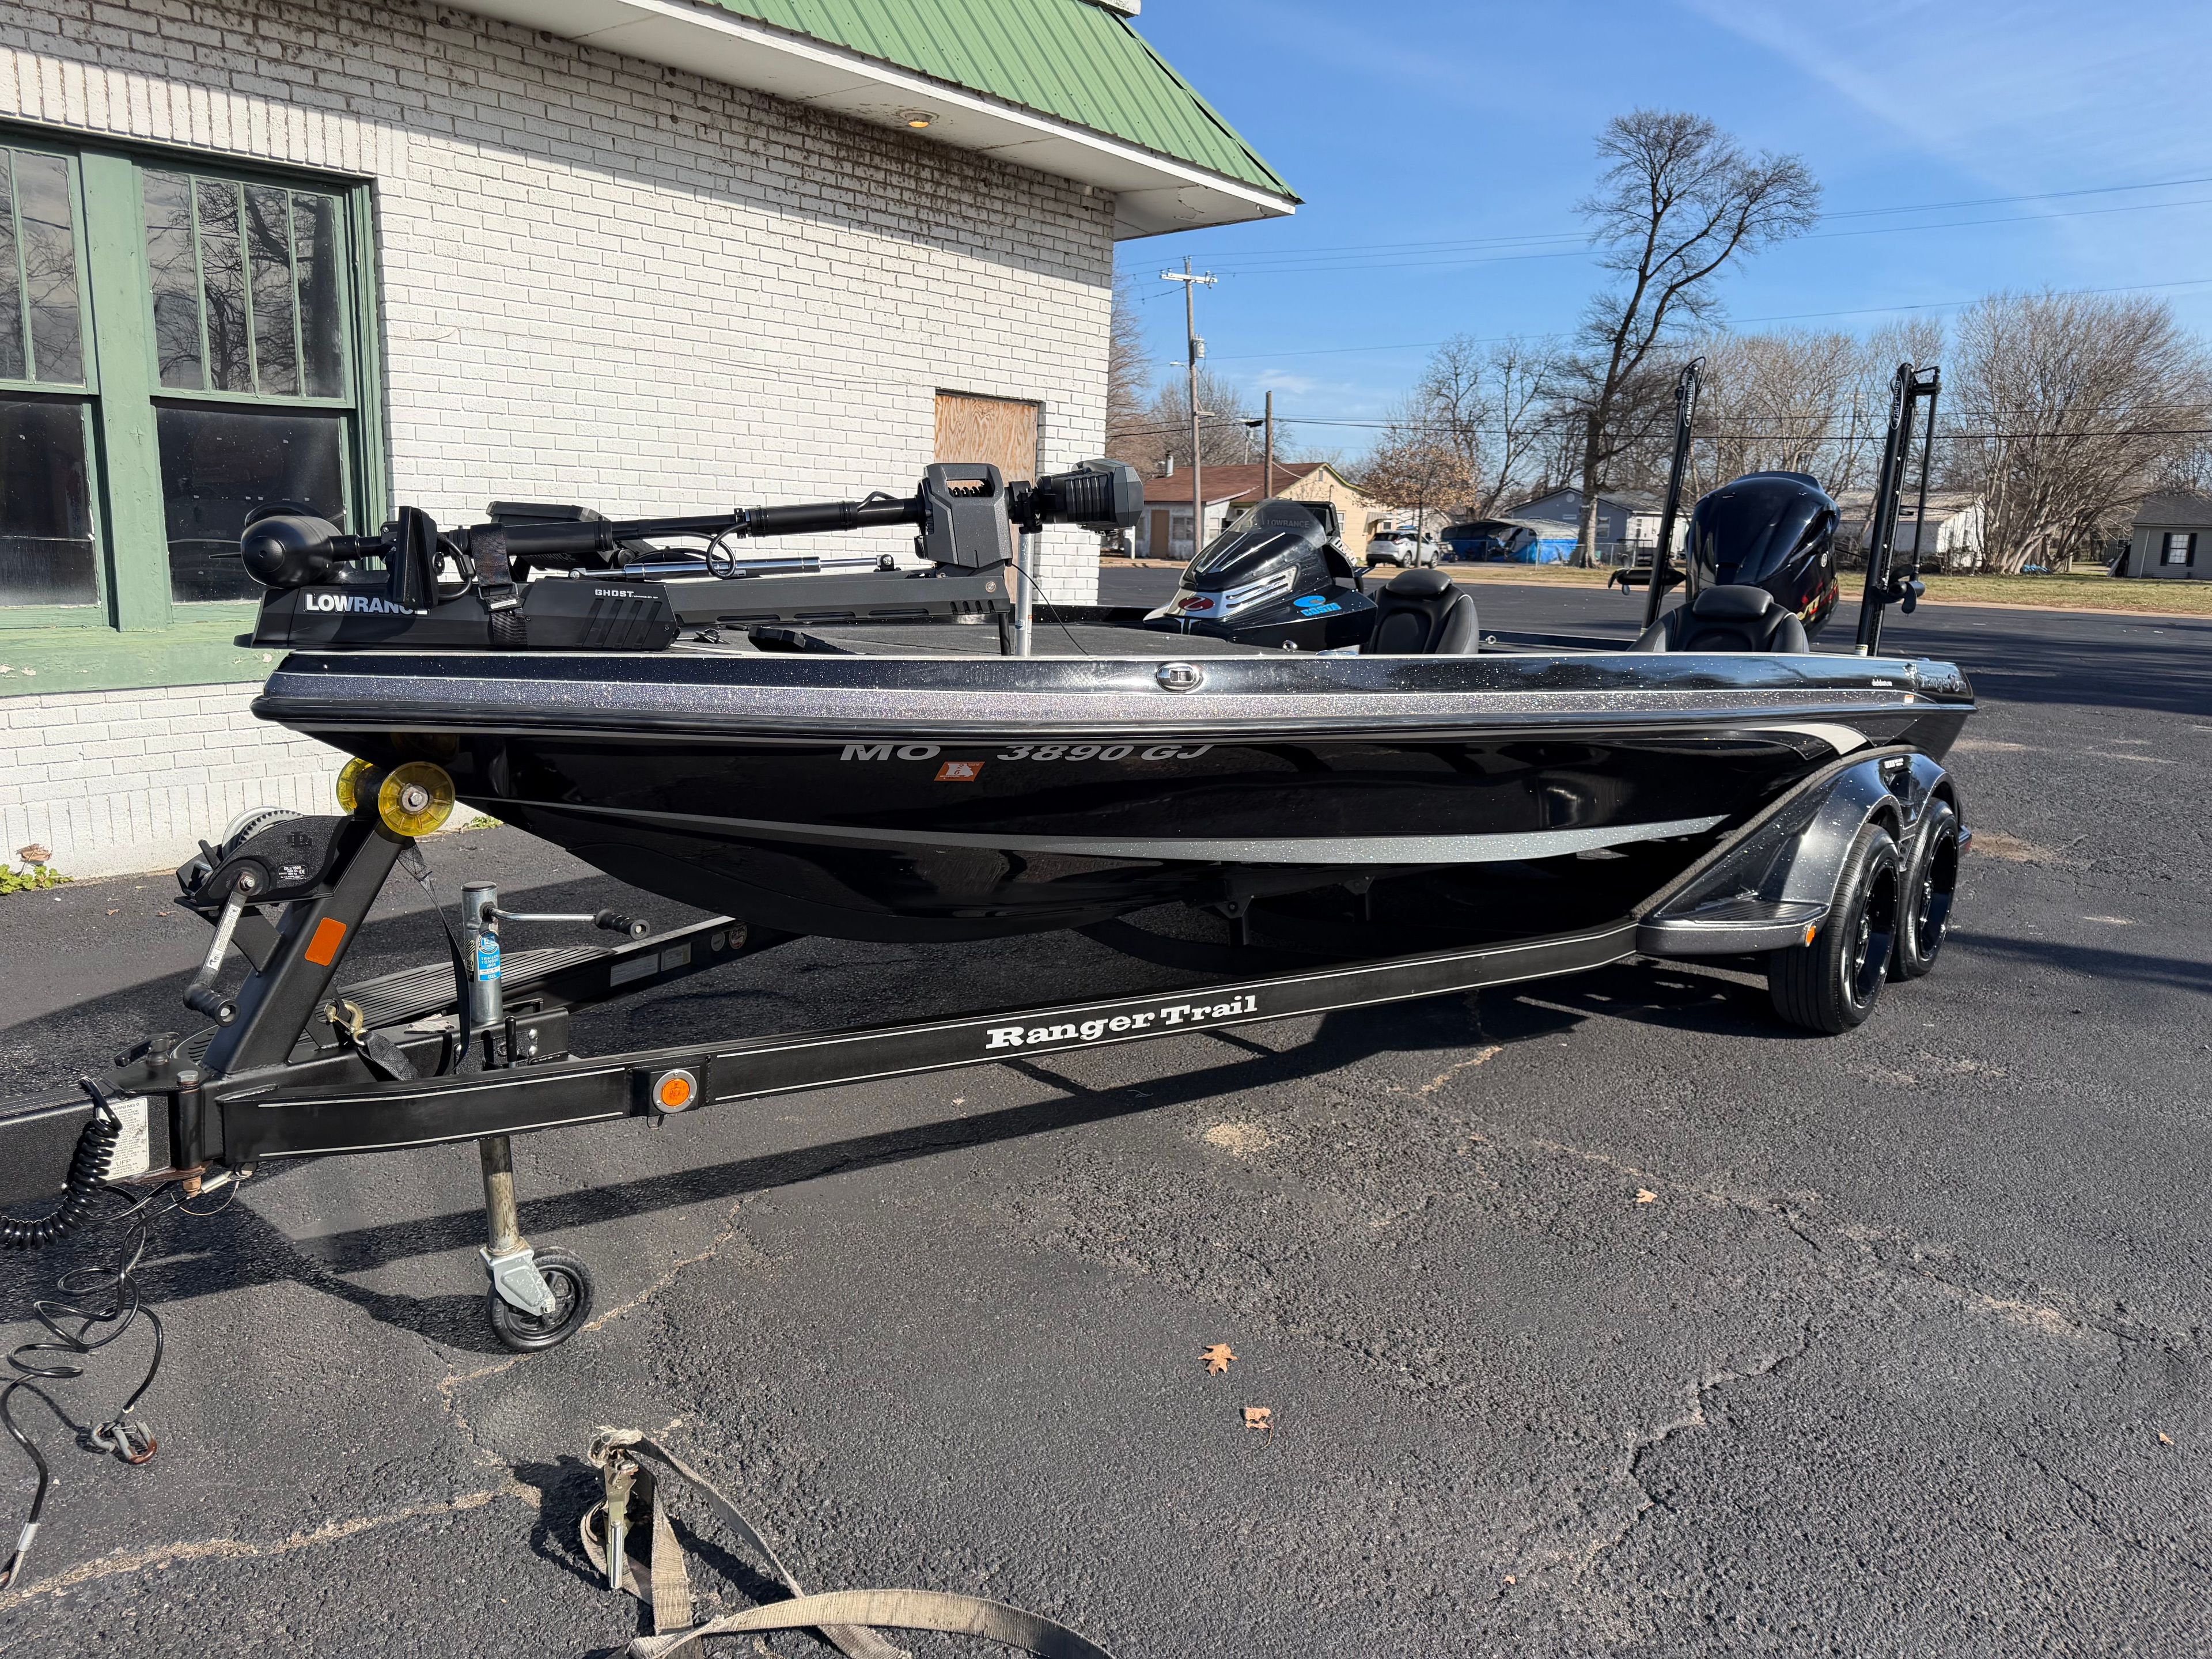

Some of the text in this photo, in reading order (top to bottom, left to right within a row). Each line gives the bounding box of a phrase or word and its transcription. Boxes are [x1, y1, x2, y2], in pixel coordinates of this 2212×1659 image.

[594, 589, 634, 597] GHOST
[1300, 602, 1342, 616] COSTA
[840, 744, 1214, 761] MO 3890 GJ
[116, 1158, 131, 1166] UFP
